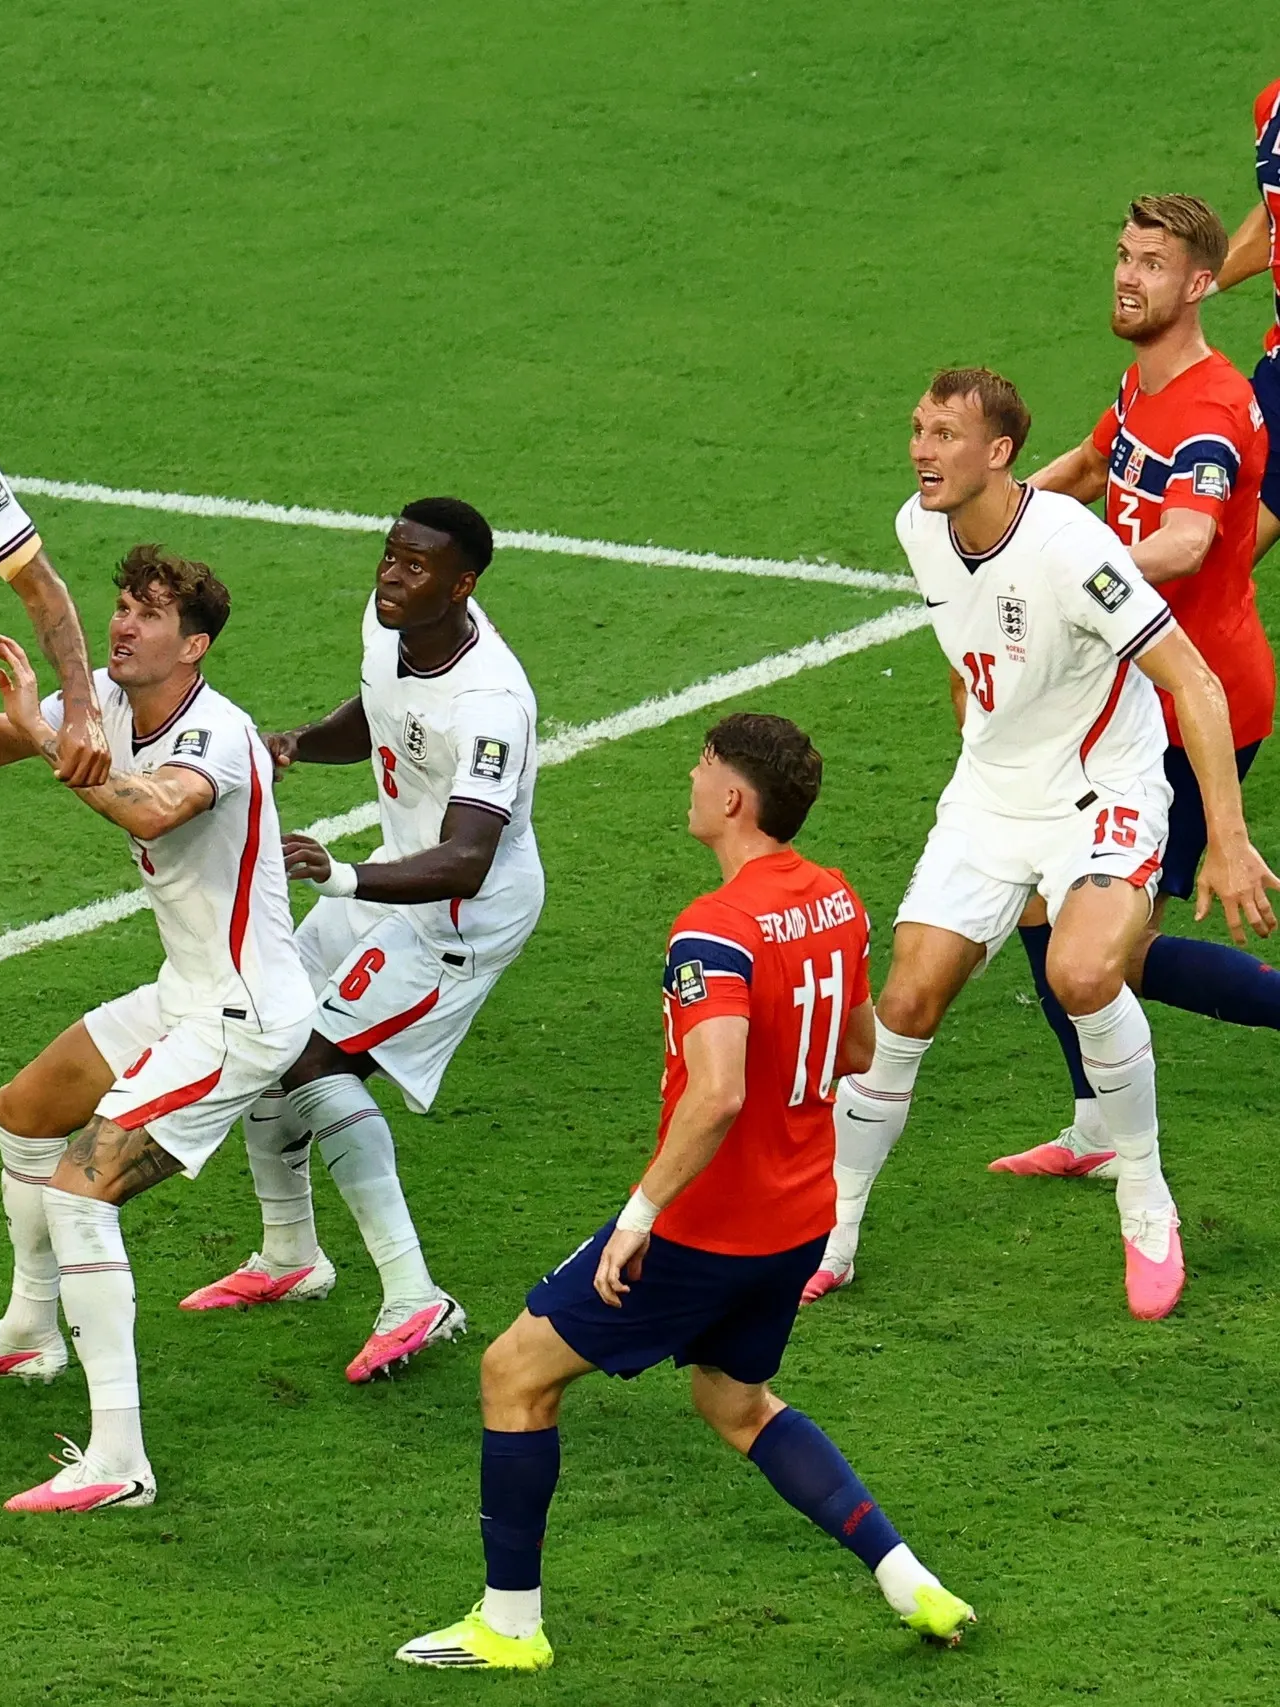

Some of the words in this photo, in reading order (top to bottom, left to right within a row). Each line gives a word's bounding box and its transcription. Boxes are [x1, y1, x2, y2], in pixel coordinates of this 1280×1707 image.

[963, 652, 996, 713] 15
[1093, 806, 1139, 848] 15
[339, 948, 385, 1001] 6
[788, 950, 842, 1107] 11
